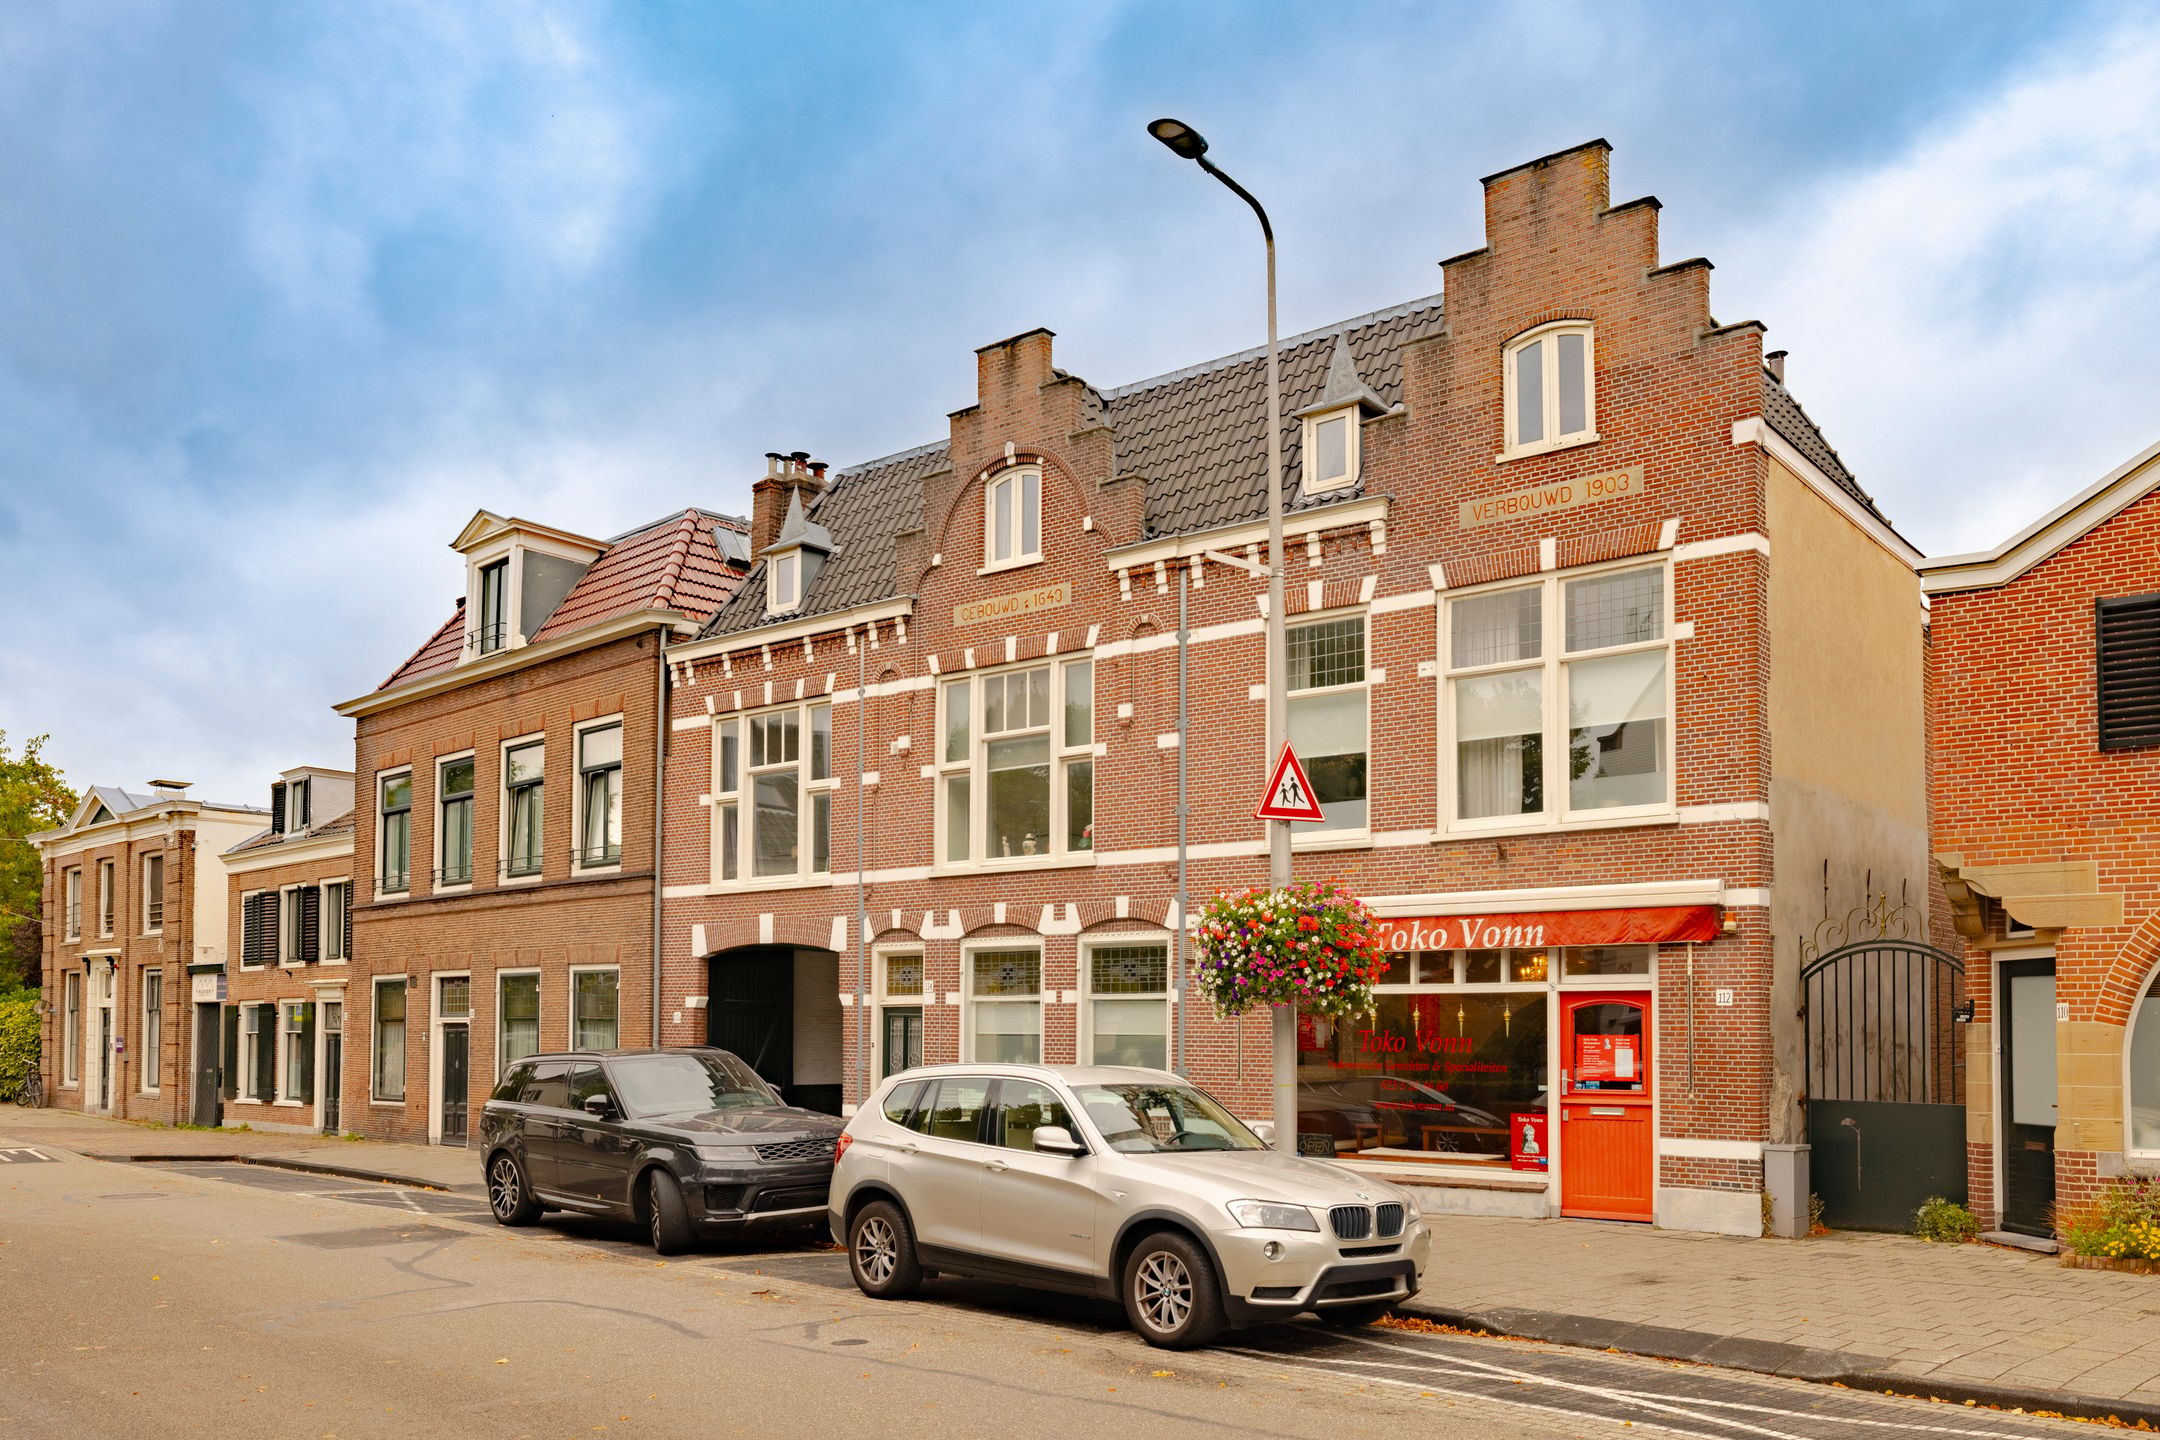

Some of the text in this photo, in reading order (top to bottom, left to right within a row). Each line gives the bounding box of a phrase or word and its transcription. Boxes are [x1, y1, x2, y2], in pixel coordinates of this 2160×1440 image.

[1472, 473, 1630, 521] VERBOUWD 1903
[1033, 588, 1063, 607] 1643
[1378, 918, 1545, 951] Toko Vonn
[1717, 992, 1731, 1004] 112
[2057, 1006, 2069, 1019] 110
[1358, 1030, 1407, 1053] Toko
[1414, 1030, 1474, 1054] Vonn
[1299, 1140, 1331, 1153] OPEN
